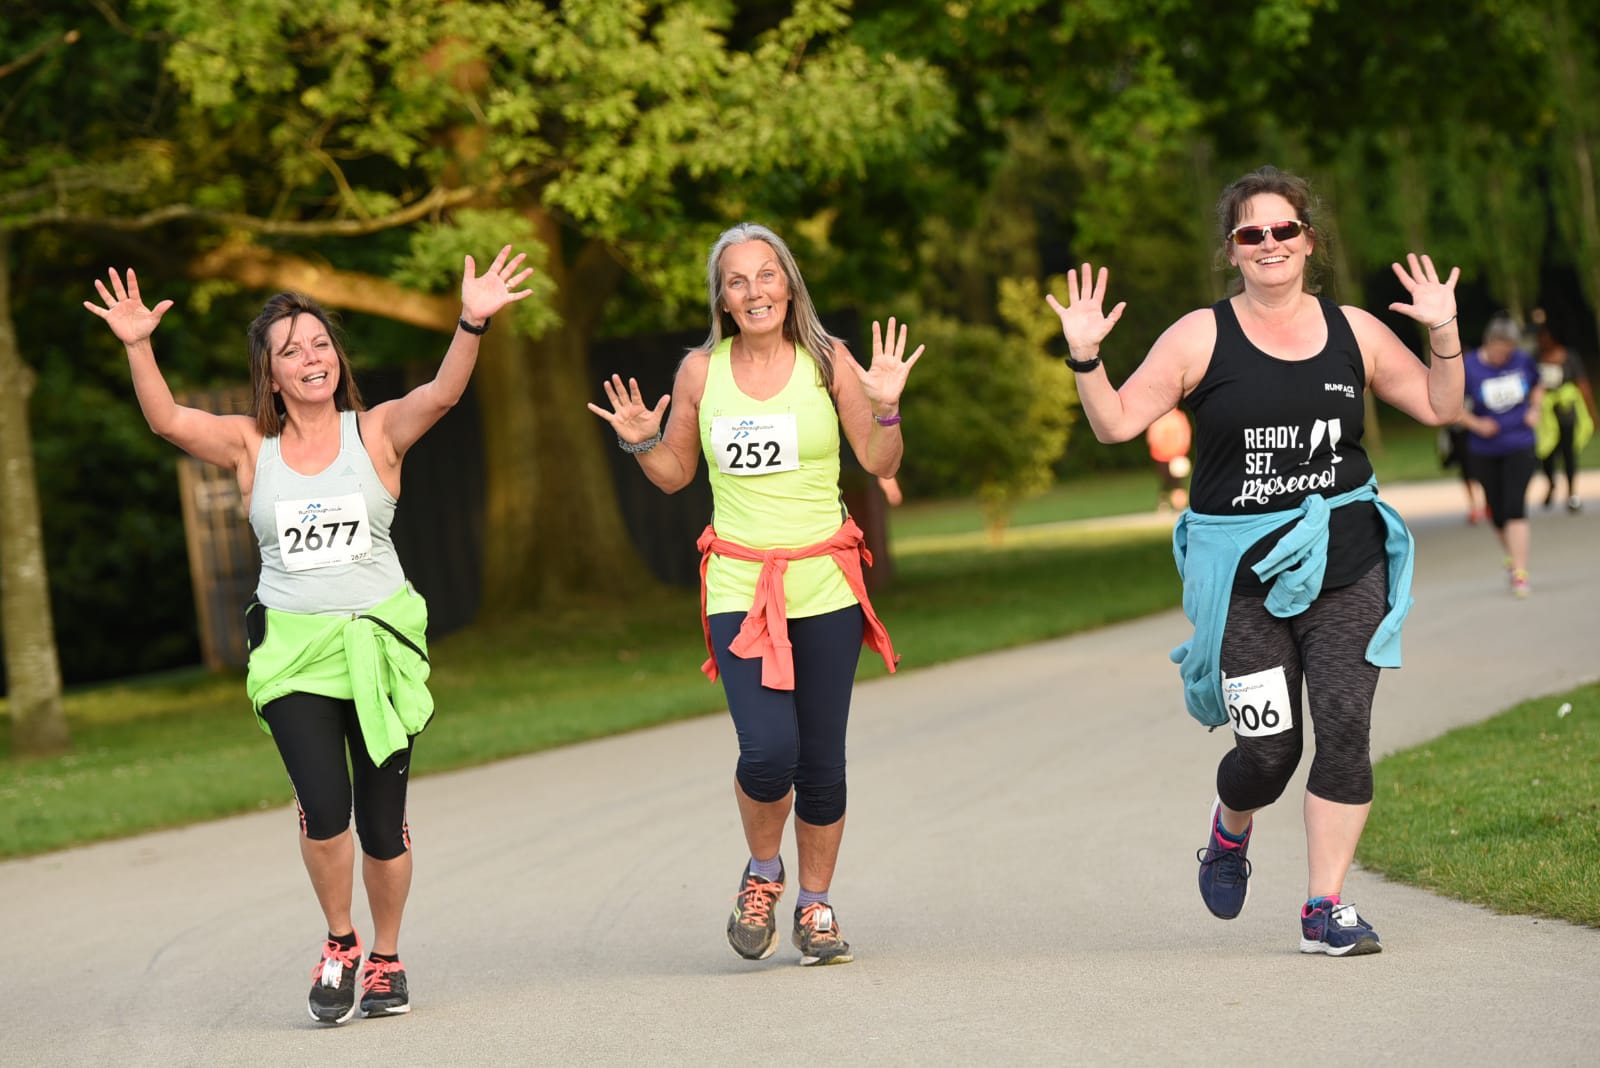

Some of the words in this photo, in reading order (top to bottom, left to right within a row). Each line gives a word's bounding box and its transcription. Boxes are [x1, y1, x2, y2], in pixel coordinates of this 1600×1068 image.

[1243, 425, 1304, 450] READY.
[726, 441, 782, 469] 252
[1245, 452, 1277, 475] SET.
[1231, 465, 1336, 508] prosecco!
[284, 520, 360, 554] 2677
